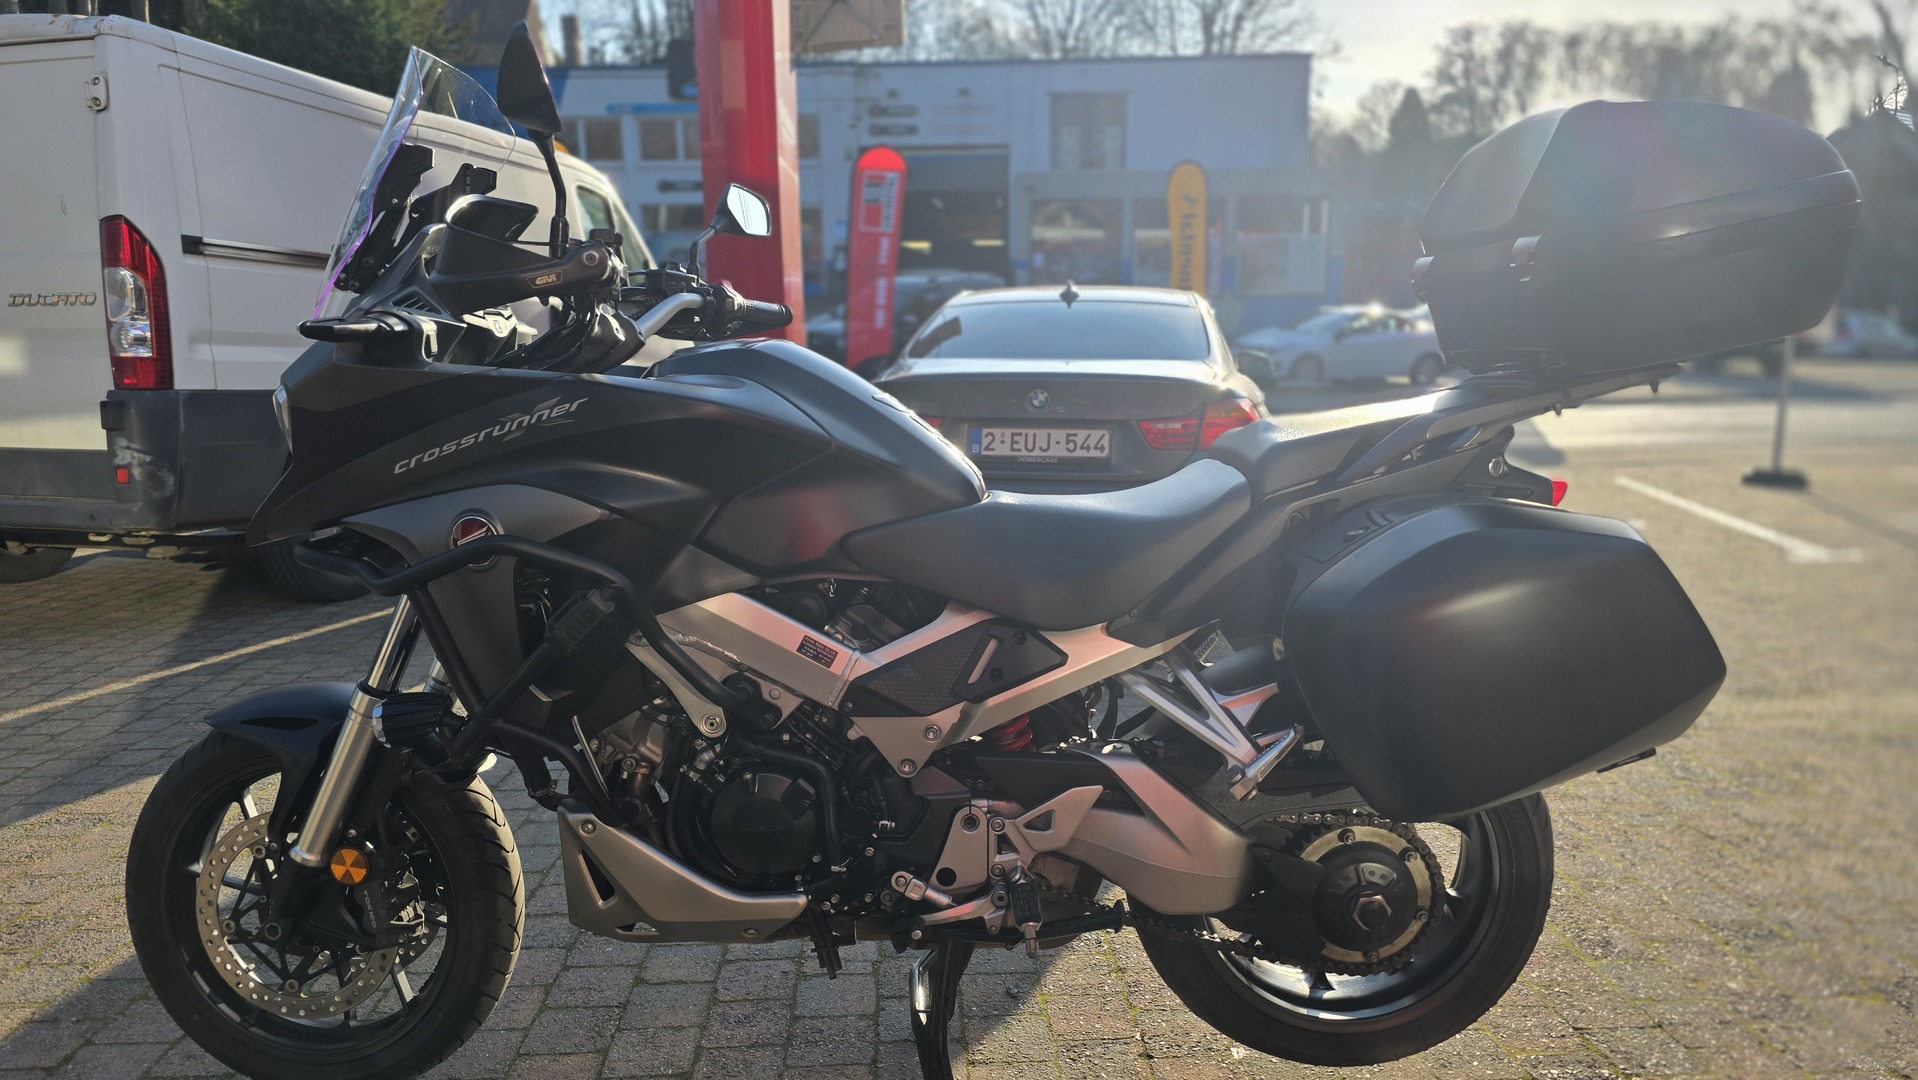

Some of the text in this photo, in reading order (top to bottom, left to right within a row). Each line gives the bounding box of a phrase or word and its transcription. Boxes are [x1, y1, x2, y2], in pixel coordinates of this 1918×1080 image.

[535, 273, 557, 285] GIVI
[8, 293, 97, 307] DUCATO
[394, 397, 589, 474] crossrunner
[983, 431, 1107, 454] 2-EUJ-544
[972, 443, 980, 454] B
[1017, 456, 1058, 464] POWERCARS
[363, 889, 377, 929] TOKICO
